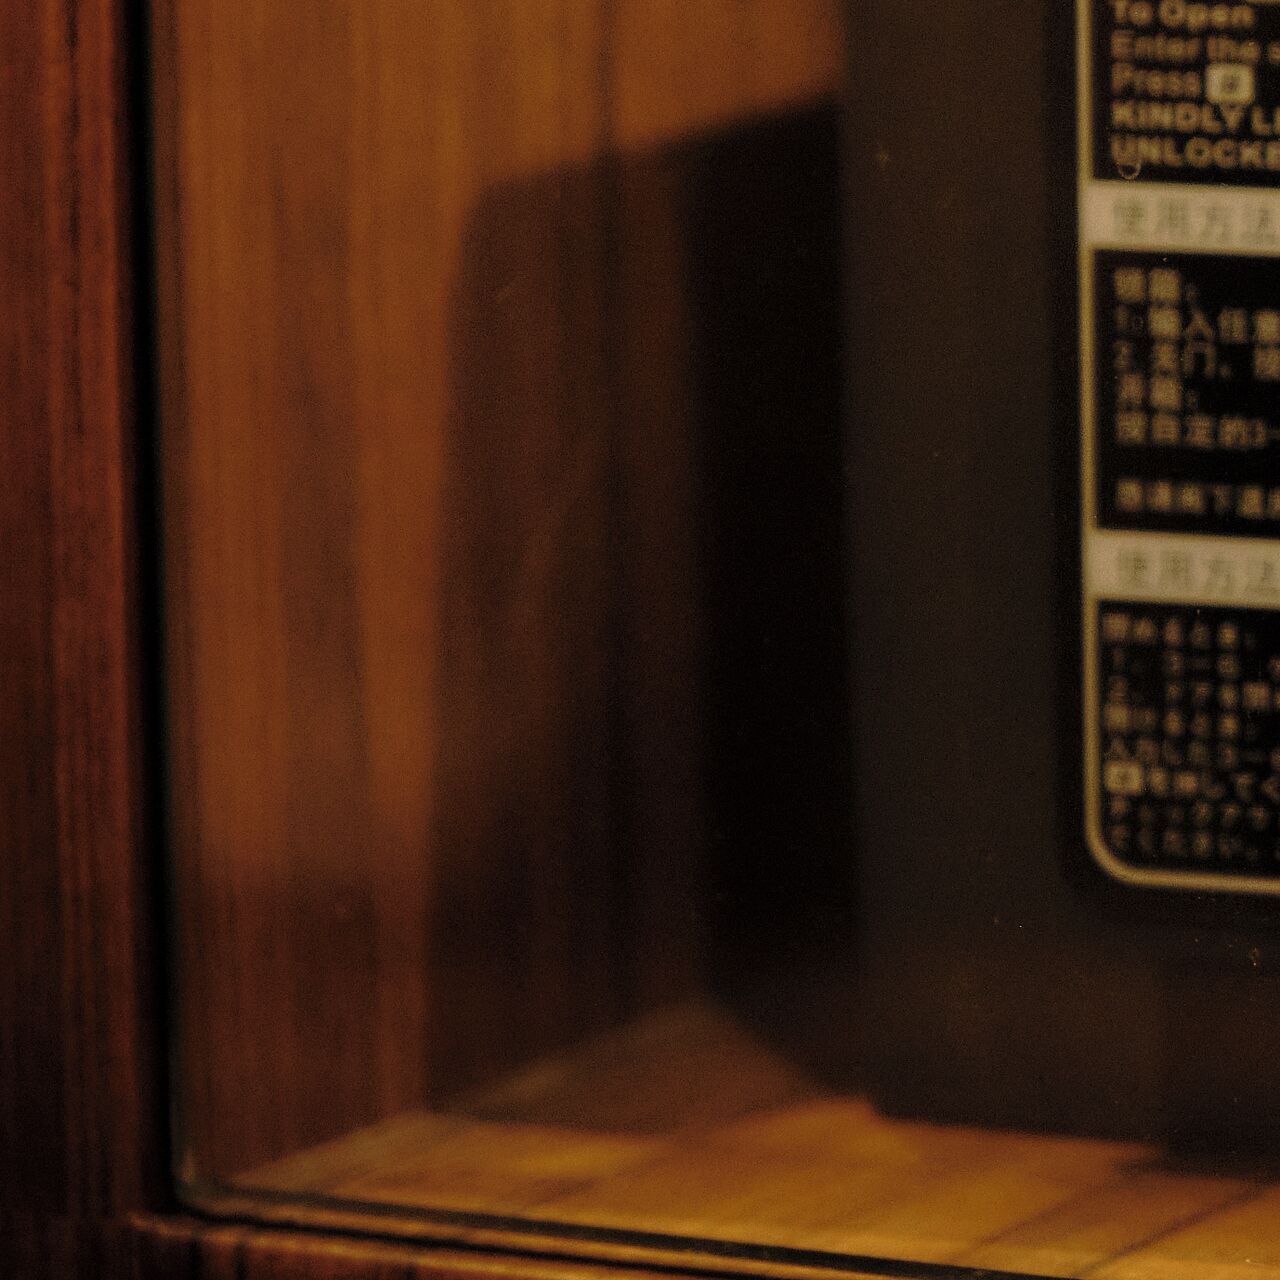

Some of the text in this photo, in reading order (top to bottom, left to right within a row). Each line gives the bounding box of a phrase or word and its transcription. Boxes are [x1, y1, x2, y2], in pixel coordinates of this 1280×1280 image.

[1109, 29, 1200, 62] Enter
[1207, 33, 1261, 64] the
[1109, 62, 1203, 98] Press
[1110, 100, 1248, 136] KINDLY
